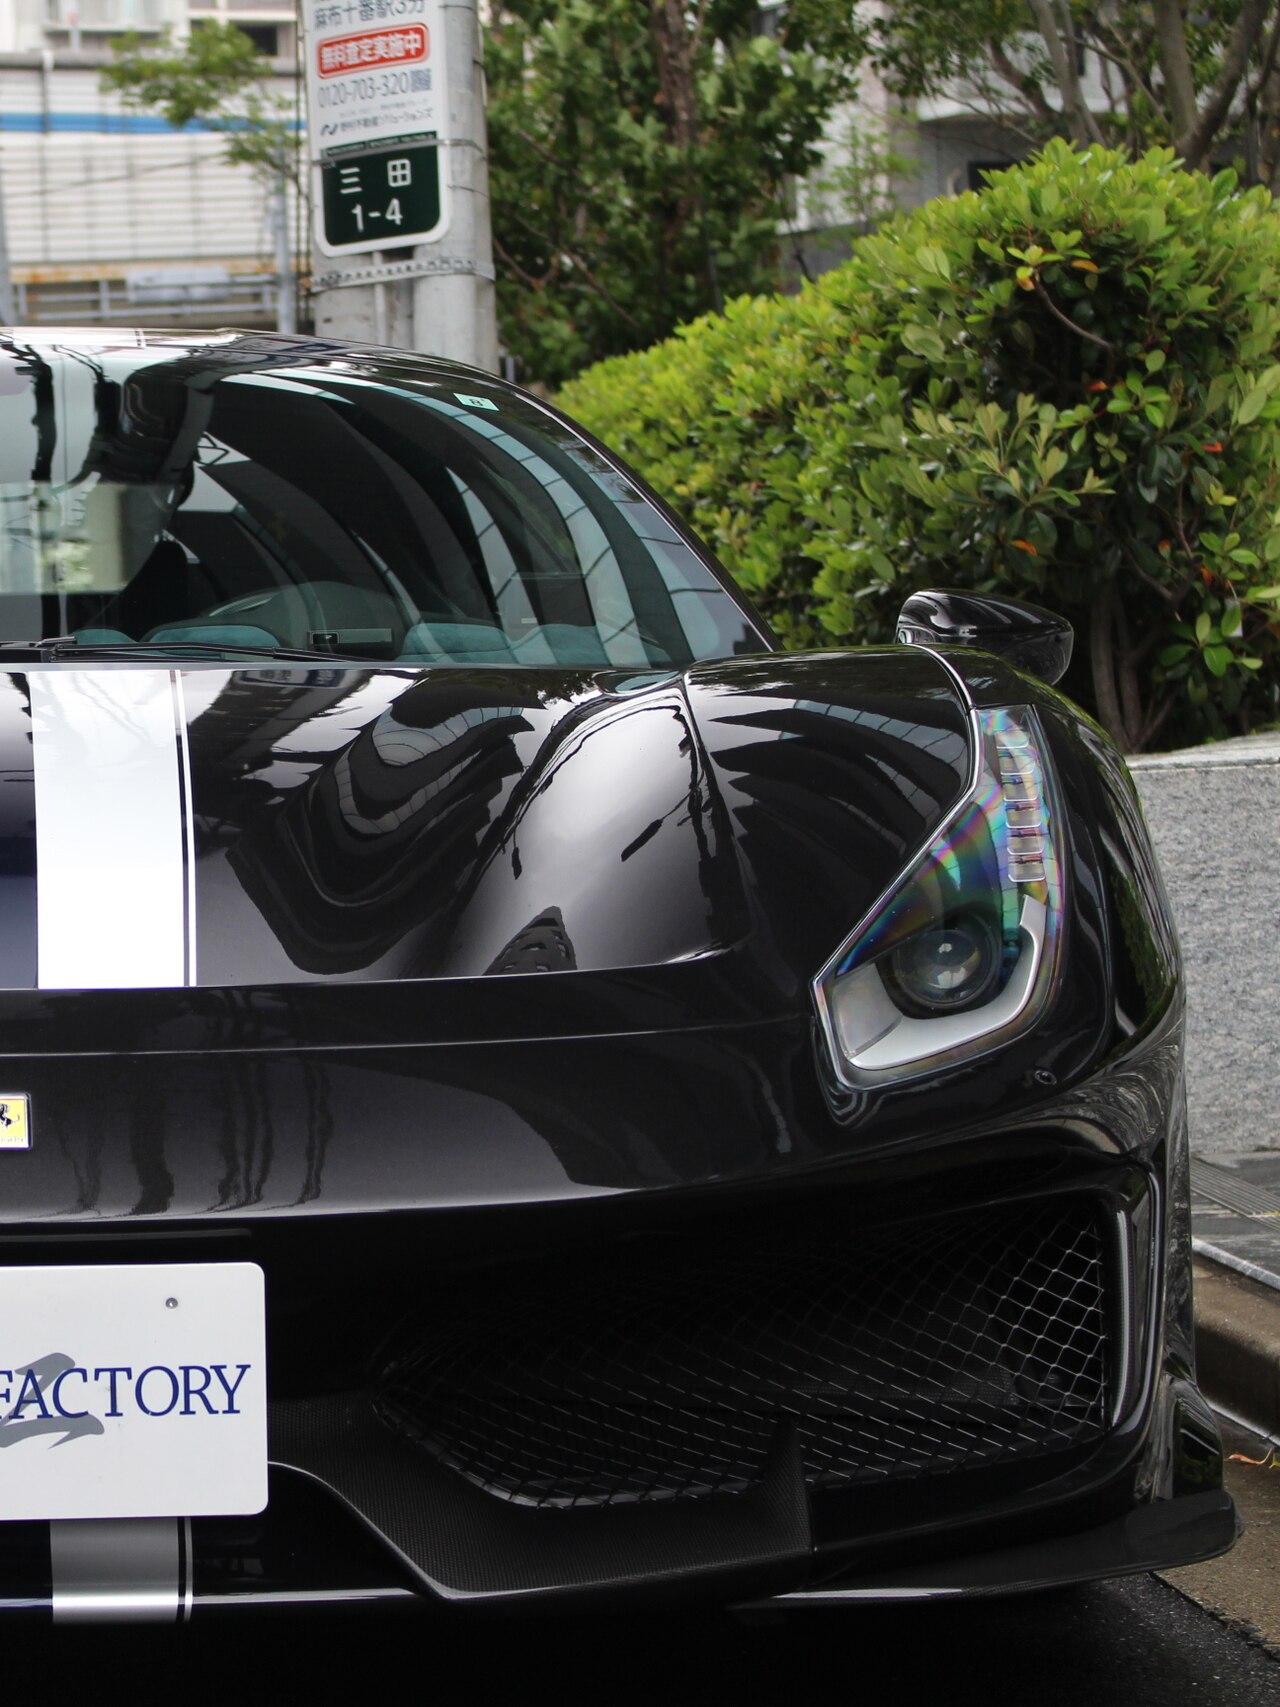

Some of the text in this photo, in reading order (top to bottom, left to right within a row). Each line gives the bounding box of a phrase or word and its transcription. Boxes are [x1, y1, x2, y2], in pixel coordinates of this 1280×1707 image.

[321, 31, 422, 70] 無料査定実施中
[318, 72, 411, 108] 0120-703-320
[351, 198, 403, 233] 1-4
